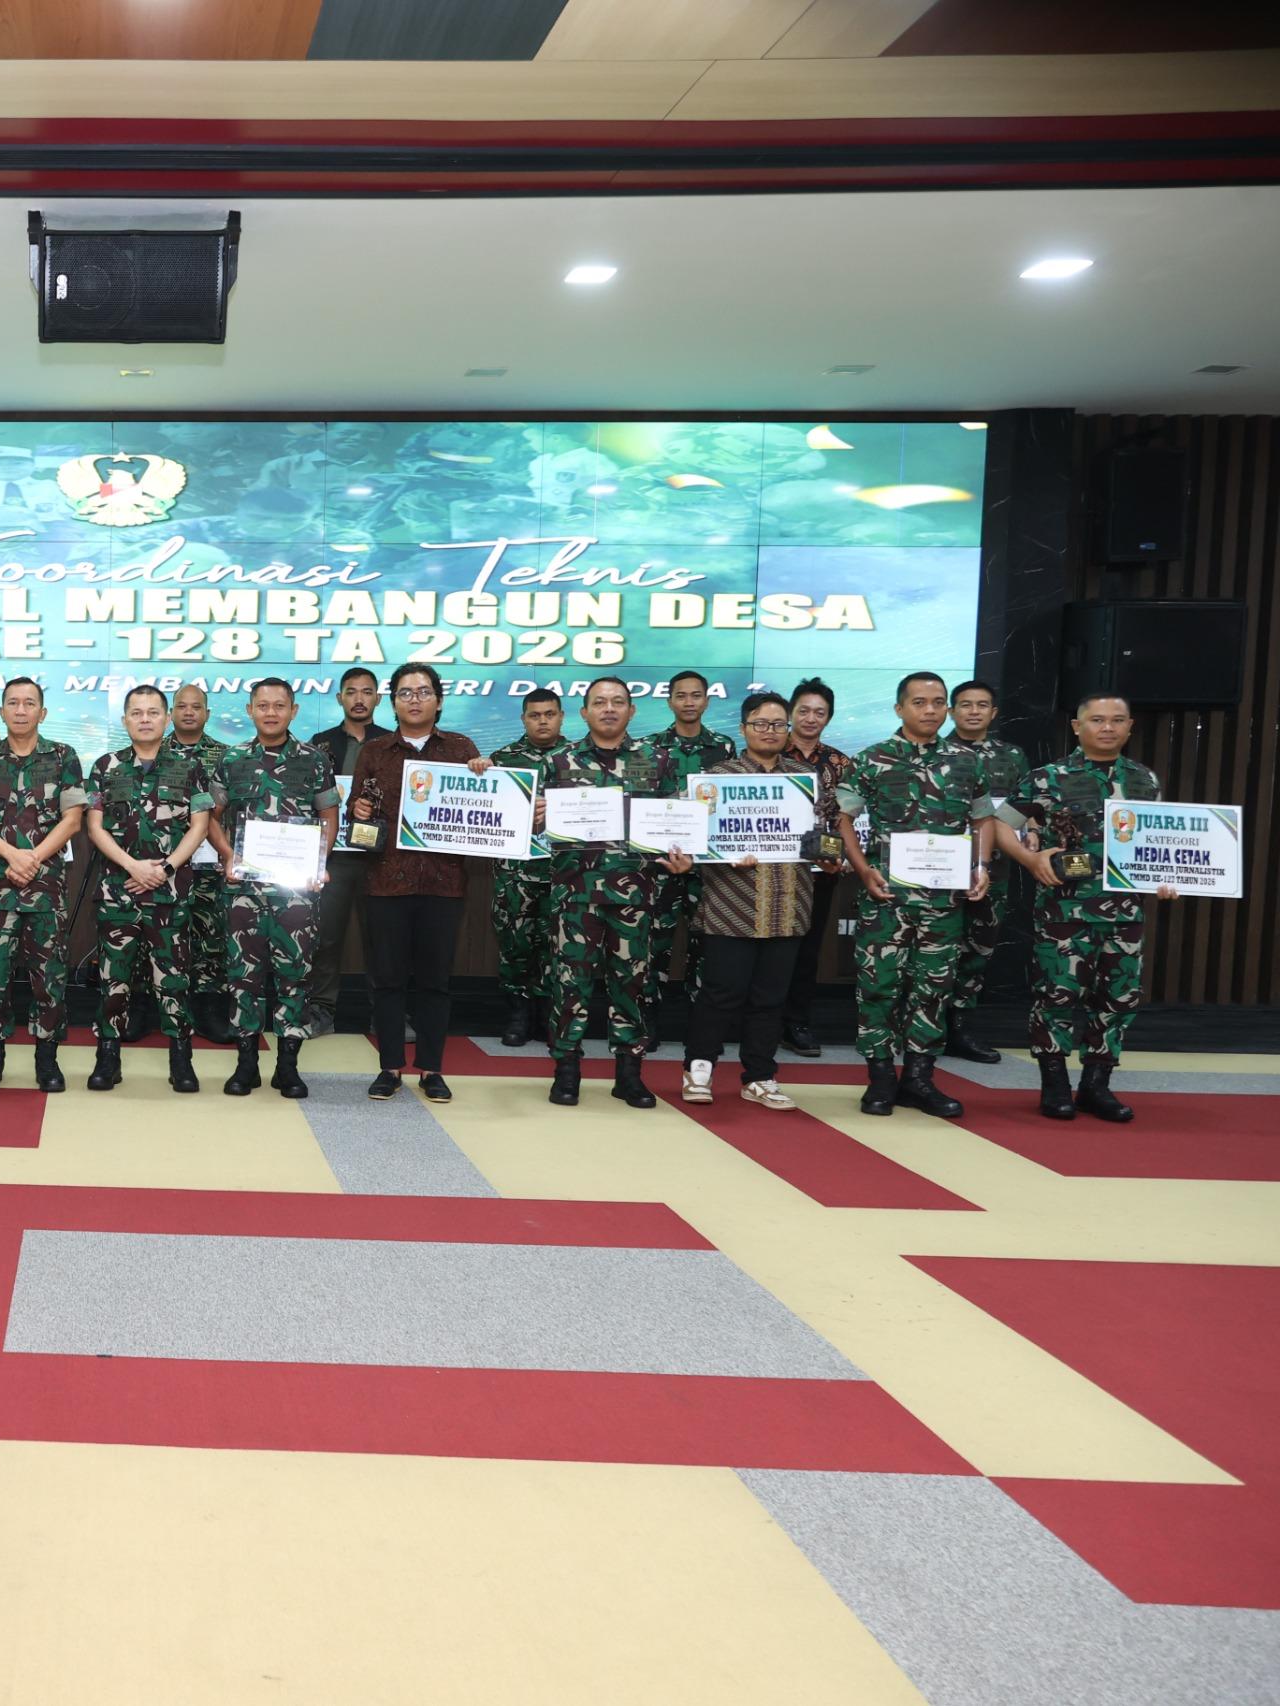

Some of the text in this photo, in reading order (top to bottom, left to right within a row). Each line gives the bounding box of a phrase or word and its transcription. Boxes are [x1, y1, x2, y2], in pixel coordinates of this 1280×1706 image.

[420, 536, 706, 600] Teknis
[65, 587, 622, 628] MEMBANGUN
[648, 592, 876, 631] DESA
[115, 627, 261, 661] 128
[283, 629, 386, 663] TA
[406, 630, 626, 665] 2026
[508, 680, 591, 697] DAR
[627, 682, 728, 698] DEA
[439, 776, 498, 793] JUARA I
[441, 796, 493, 808] KATEGORI
[722, 786, 783, 804] JUARA II
[429, 807, 502, 827] MEDIA CETAK
[728, 806, 778, 814] KATEGORI
[413, 822, 515, 837] LOMBA KARYA JURNALISTIK
[719, 818, 790, 832] MEDIA CETAK
[1136, 814, 1208, 832] JUARA III
[422, 833, 505, 847] TMMD KE-127 TAHUN 2026
[716, 844, 736, 852] TMMD
[1146, 835, 1199, 846] KATEGORI
[1135, 847, 1210, 865] MEDIA CETAK
[1120, 863, 1225, 876] LOMBA KARYA JURNALISTIK
[1130, 873, 1150, 881] TMMD
[1176, 876, 1198, 884] TAHUN
